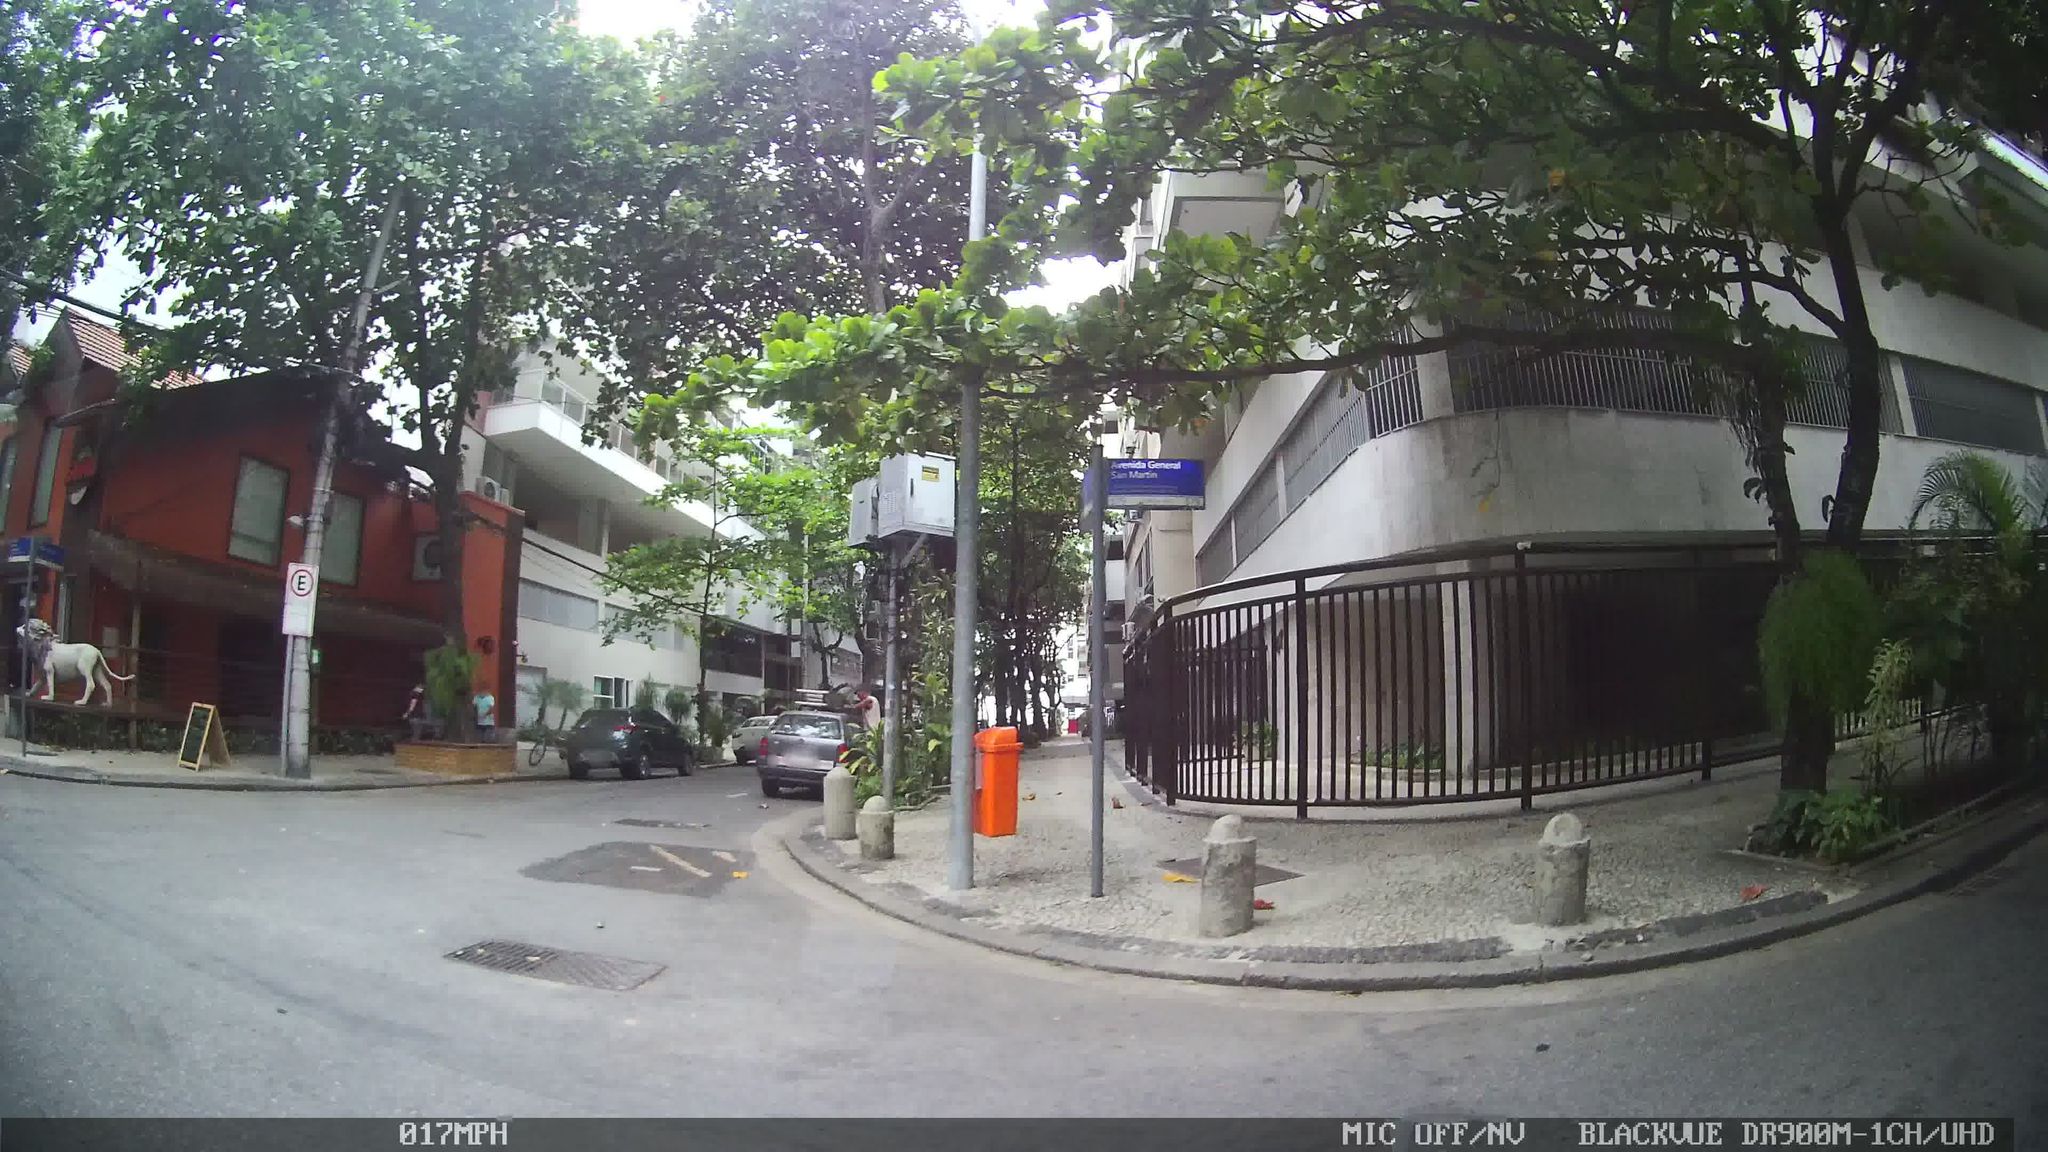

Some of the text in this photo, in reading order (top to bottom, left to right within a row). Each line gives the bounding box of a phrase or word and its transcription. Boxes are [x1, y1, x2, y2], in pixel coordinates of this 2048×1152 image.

[1111, 461, 1181, 469] Avenida General
[1111, 471, 1128, 479] San
[297, 575, 306, 590] E
